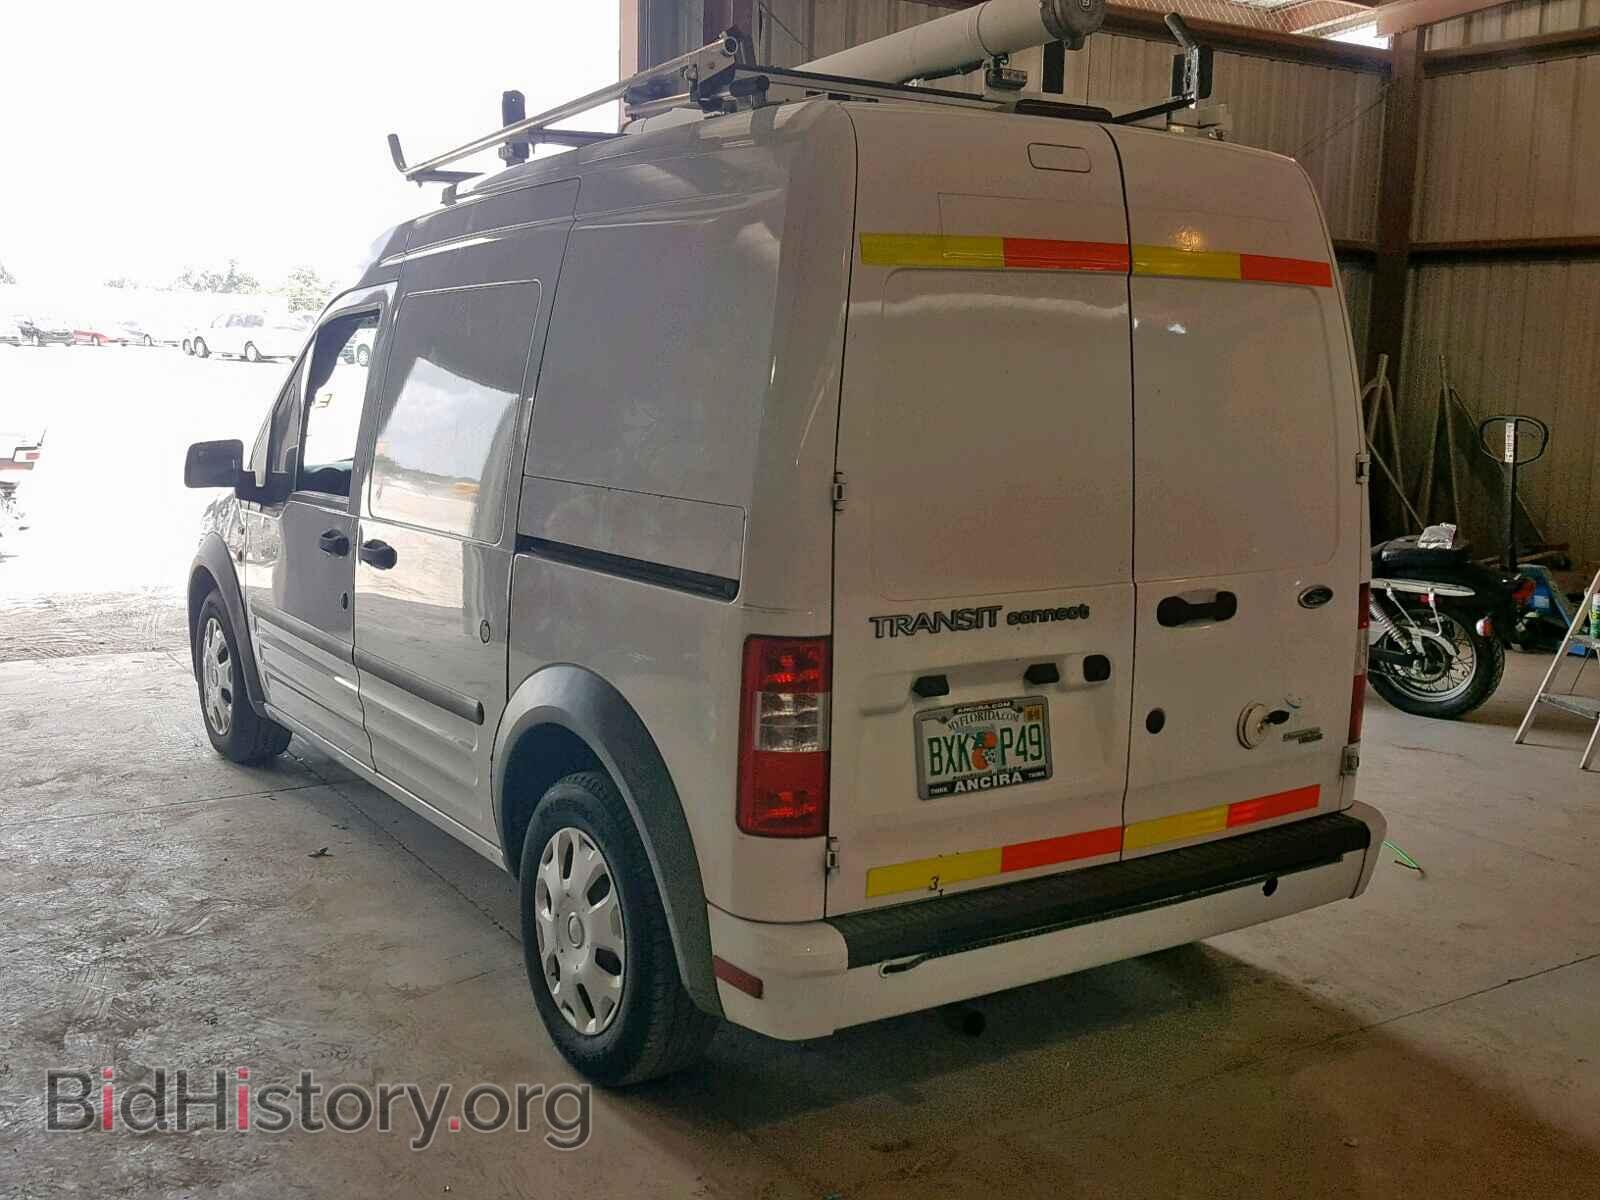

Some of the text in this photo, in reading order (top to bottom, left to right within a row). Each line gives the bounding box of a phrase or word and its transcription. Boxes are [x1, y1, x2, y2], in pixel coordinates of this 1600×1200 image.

[869, 603, 1090, 639] TRANSIT connect
[928, 723, 1043, 777] BXK P49
[954, 771, 1023, 793] ANCIRA
